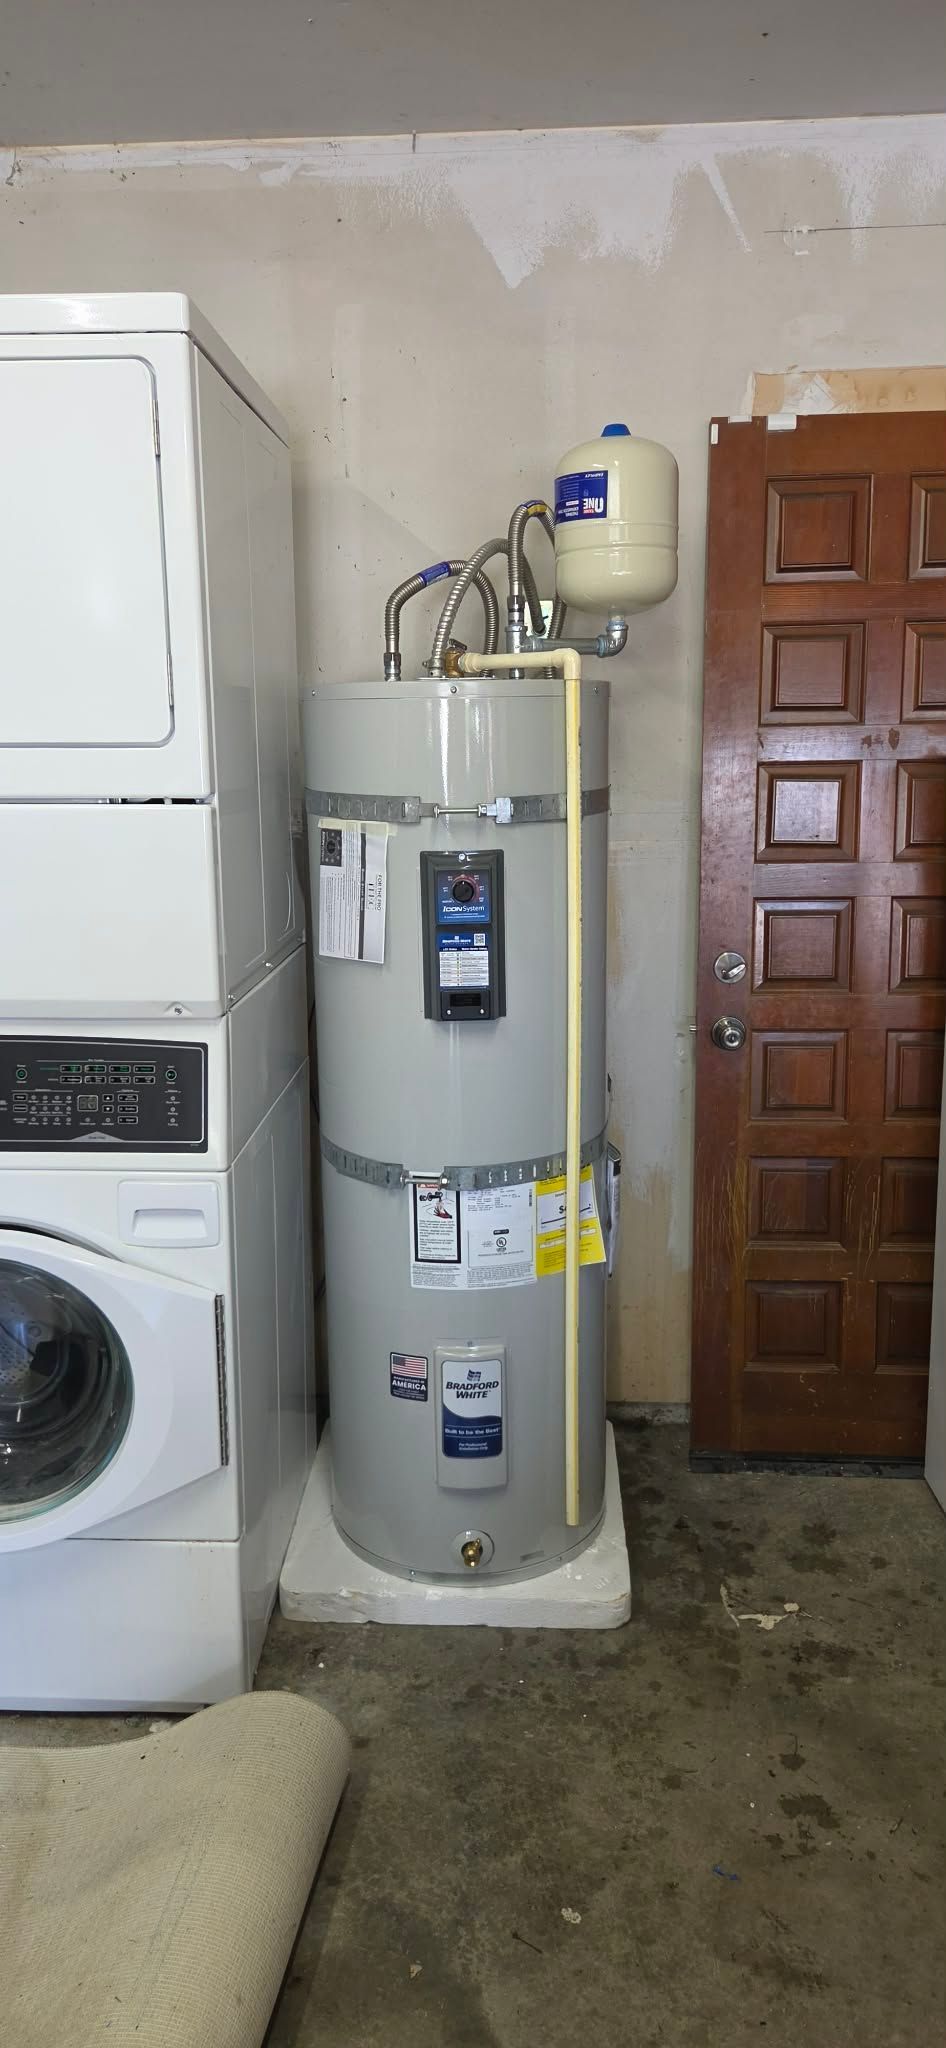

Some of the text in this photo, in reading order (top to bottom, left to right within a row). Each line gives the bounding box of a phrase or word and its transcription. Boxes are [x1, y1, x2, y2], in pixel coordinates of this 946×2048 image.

[583, 497, 604, 513] ONE
[392, 1379, 426, 1391] AMERICA
[446, 1380, 499, 1391] BRADFORD
[456, 1390, 488, 1399] WHITE
